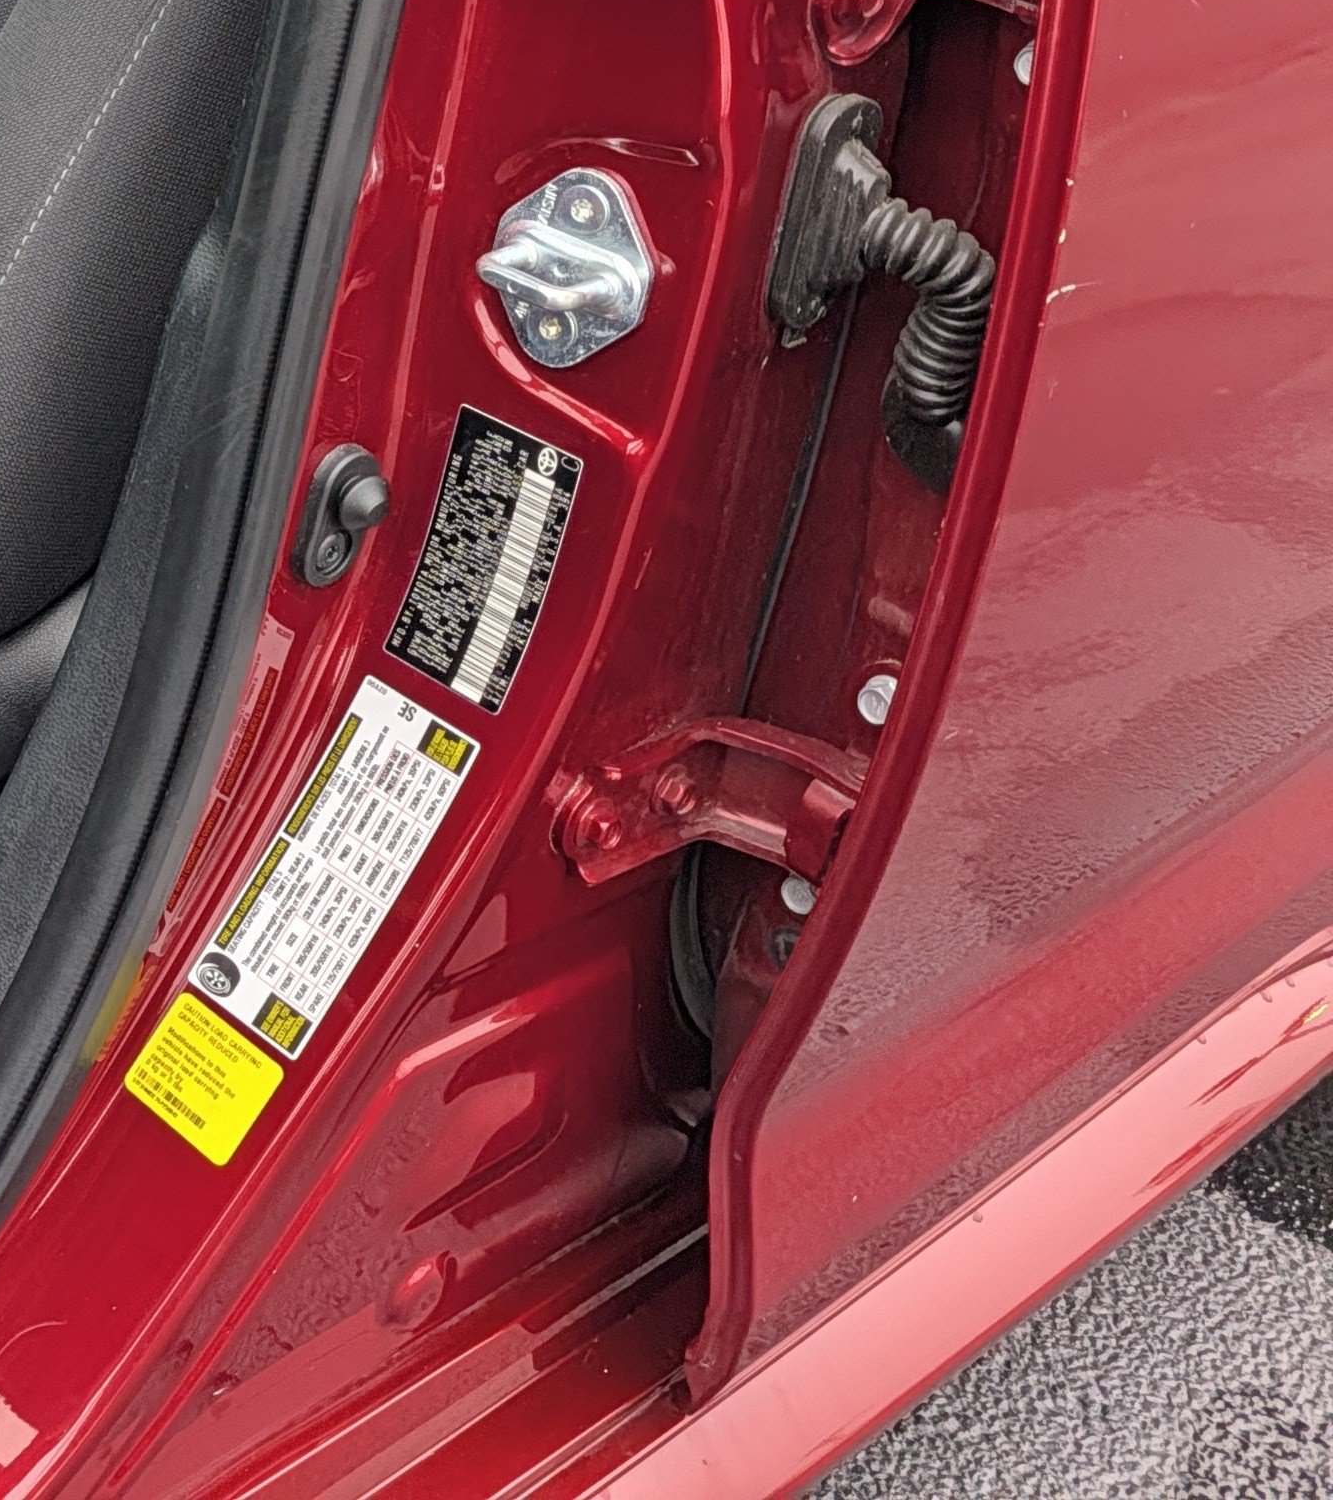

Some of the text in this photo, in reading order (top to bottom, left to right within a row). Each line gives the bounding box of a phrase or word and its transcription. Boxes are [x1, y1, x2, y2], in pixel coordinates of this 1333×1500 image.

[422, 533, 439, 566] MOTOR
[433, 452, 462, 531] MANUFACTURING
[530, 577, 546, 604] MADE
[448, 624, 465, 651] DATE
[396, 700, 418, 722] SE
[337, 797, 380, 862] PNEU DIMENSIONS
[271, 880, 287, 901] FRONT
[287, 855, 302, 875] REAR
[351, 852, 369, 875] AVANT
[218, 839, 287, 945] TIRE AND LOADING INFORMATION
[227, 926, 247, 954] SEATING
[242, 898, 264, 929] CAPACITY
[263, 874, 279, 895] TOTAL
[241, 955, 252, 967] The
[265, 962, 279, 979] TIRE
[285, 931, 298, 947] SIZE
[279, 971, 295, 993] FRONT
[293, 982, 309, 1002] REAR
[307, 992, 324, 1014] SPARE
[167, 1025, 227, 1078] Modifications to this
[177, 1010, 239, 1064] CAPACITY REDUCED
[228, 1038, 262, 1069] CARRYING
[149, 1051, 175, 1076] capacity
[155, 1042, 180, 1066] original
[192, 1074, 219, 1101] carrying
[182, 1052, 199, 1069] have
[198, 1064, 224, 1090] reduced
